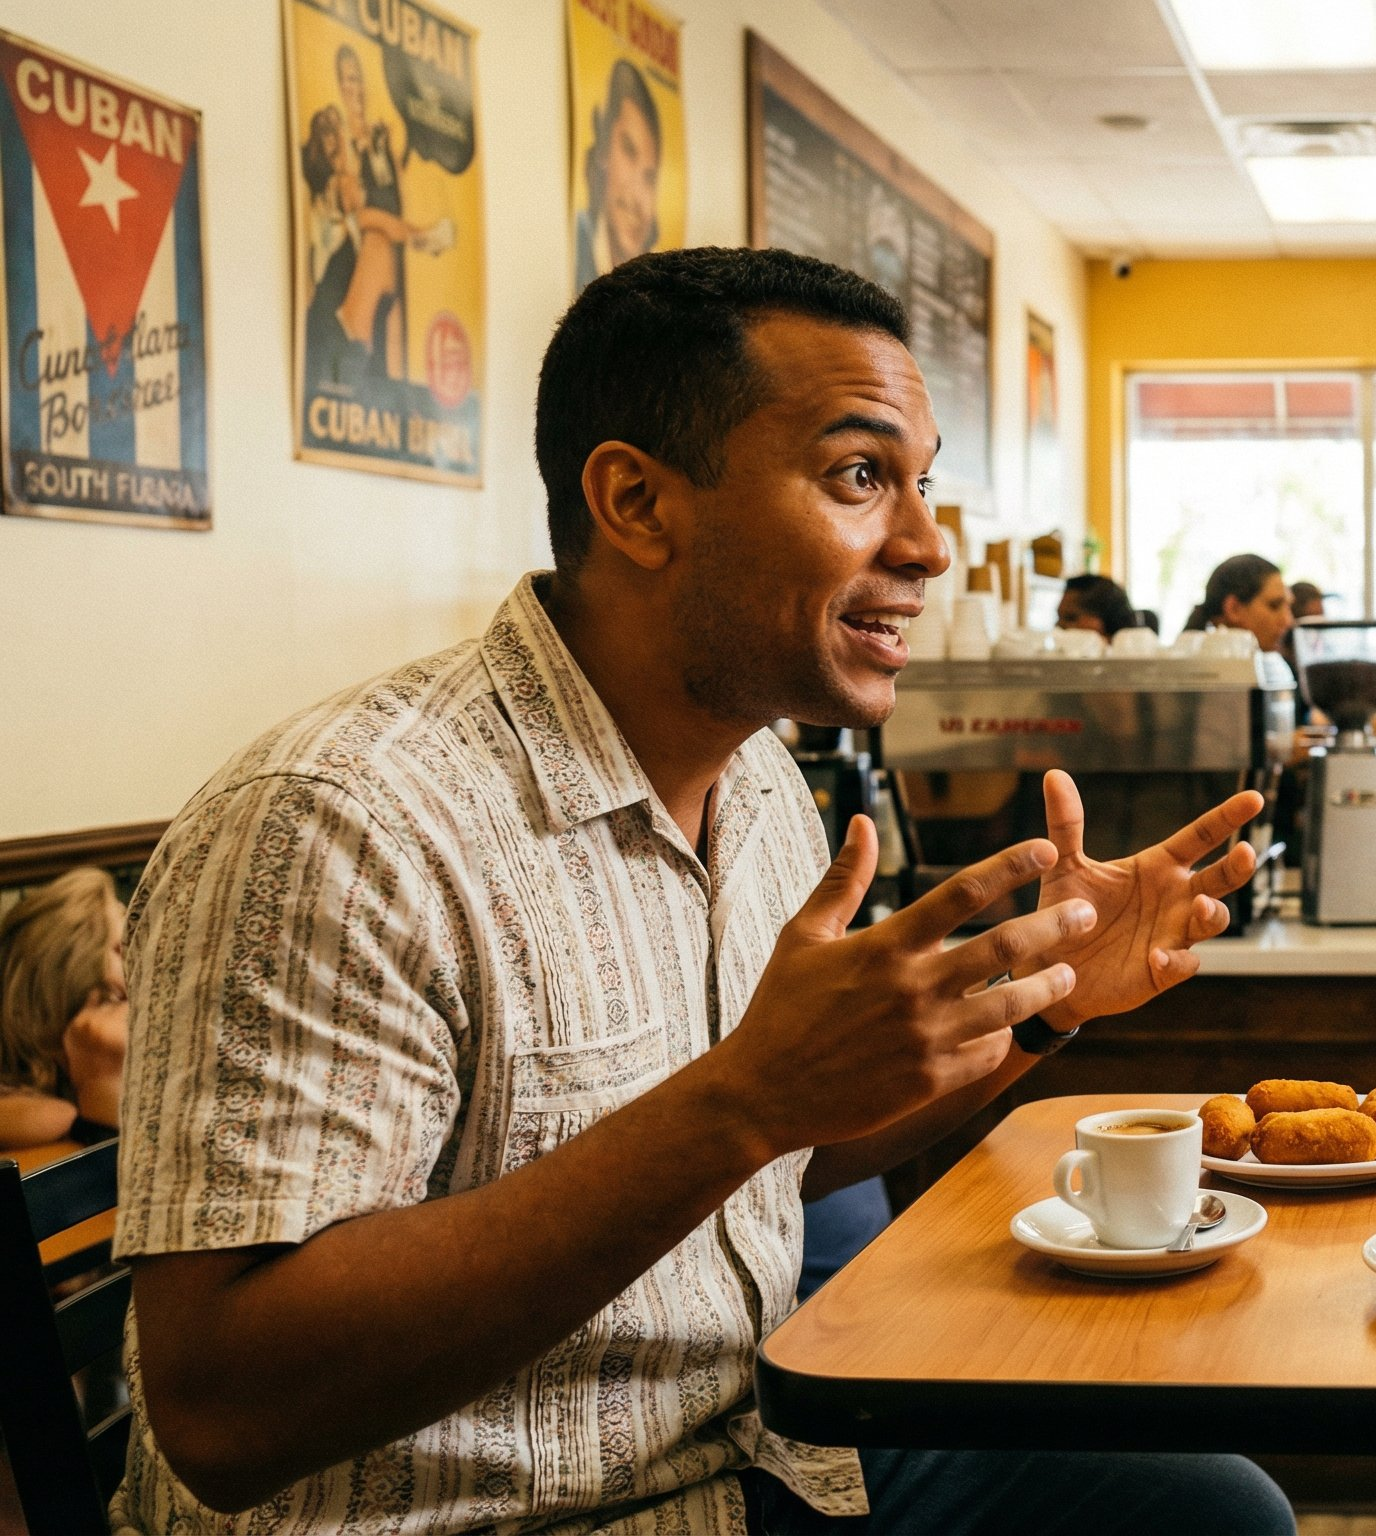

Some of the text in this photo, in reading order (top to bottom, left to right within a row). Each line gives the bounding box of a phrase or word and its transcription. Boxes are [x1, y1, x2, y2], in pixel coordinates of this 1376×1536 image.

[358, 0, 466, 80] CUBAN
[15, 57, 184, 165] CUBAN
[308, 396, 400, 450] CUBAN
[24, 461, 110, 501] SOUTH
